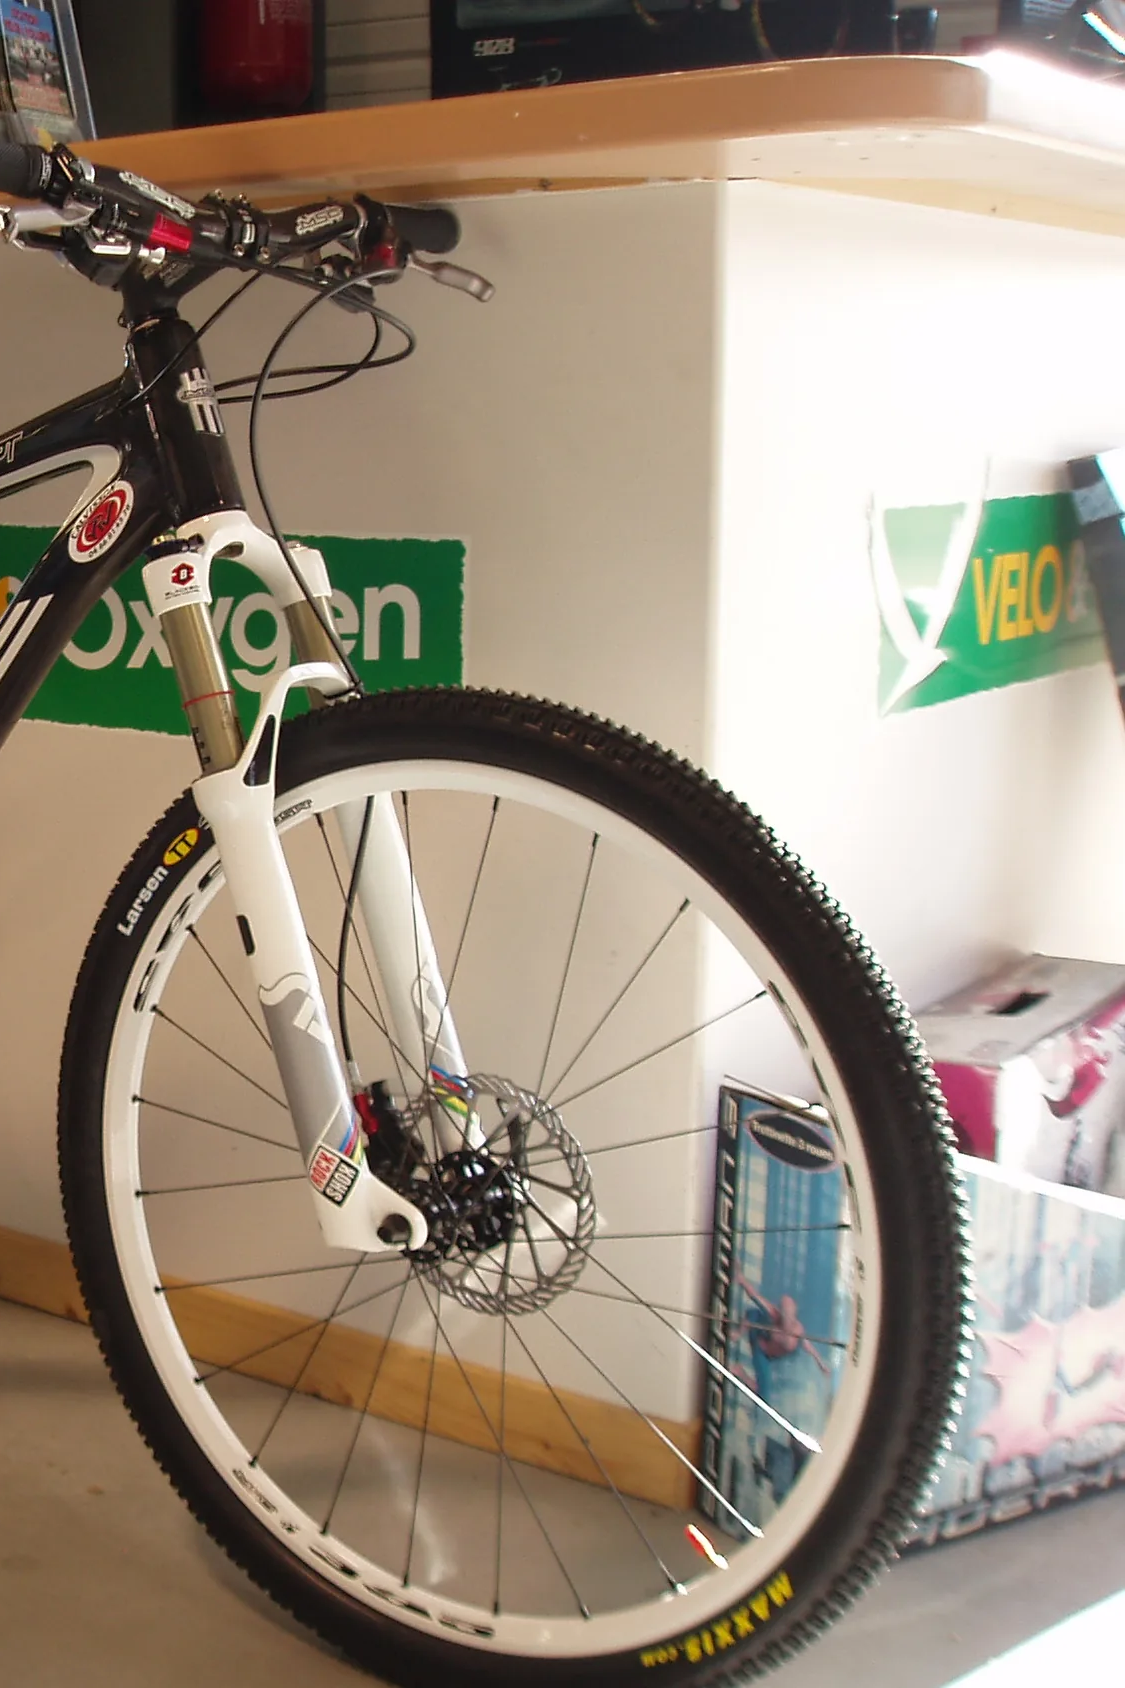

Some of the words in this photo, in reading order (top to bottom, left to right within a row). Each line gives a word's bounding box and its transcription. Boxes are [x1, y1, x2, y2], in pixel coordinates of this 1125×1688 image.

[296, 205, 344, 235] MSC
[972, 544, 1064, 645] VELO
[61, 583, 422, 693] Oxgen
[117, 865, 169, 937] Larsen
[310, 1150, 336, 1189] ROCK
[325, 1162, 356, 1202] SHOX
